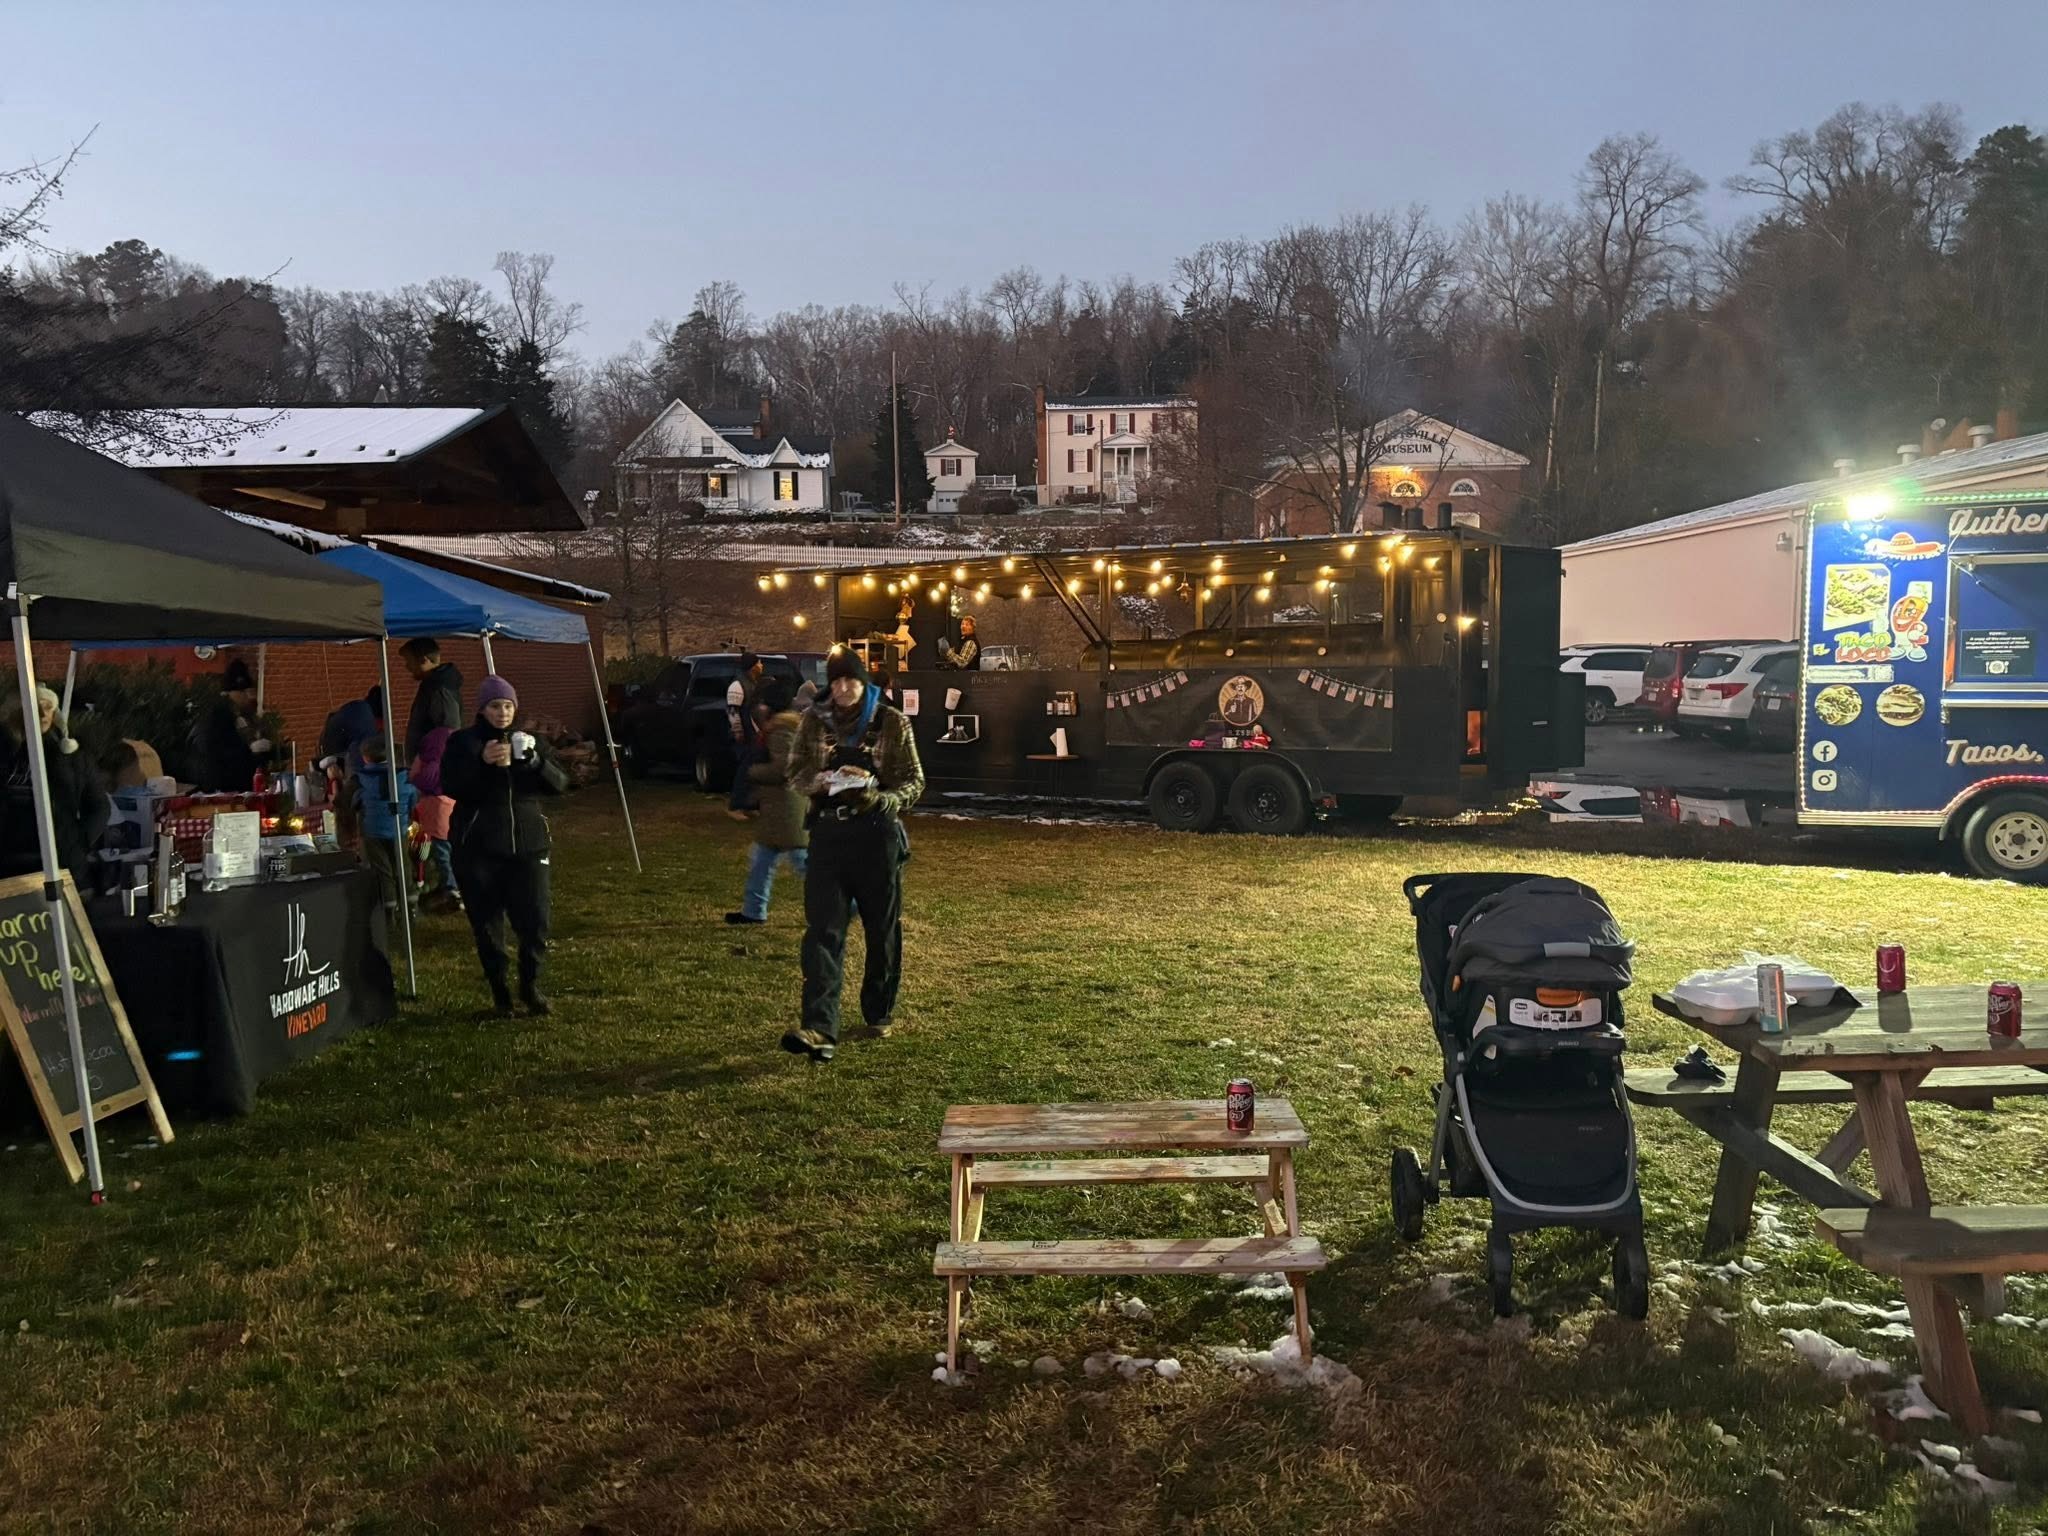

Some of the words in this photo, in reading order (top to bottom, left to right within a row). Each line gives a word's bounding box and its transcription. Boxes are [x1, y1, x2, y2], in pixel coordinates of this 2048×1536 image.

[1383, 444, 1432, 454] MUSEUM
[1834, 631, 1892, 649] TACO
[1835, 645, 1892, 662] LOCO
[1945, 739, 2045, 766] Tacos,
[0, 911, 53, 939] arm
[35, 942, 97, 991] hee!
[317, 970, 340, 999] HILLS
